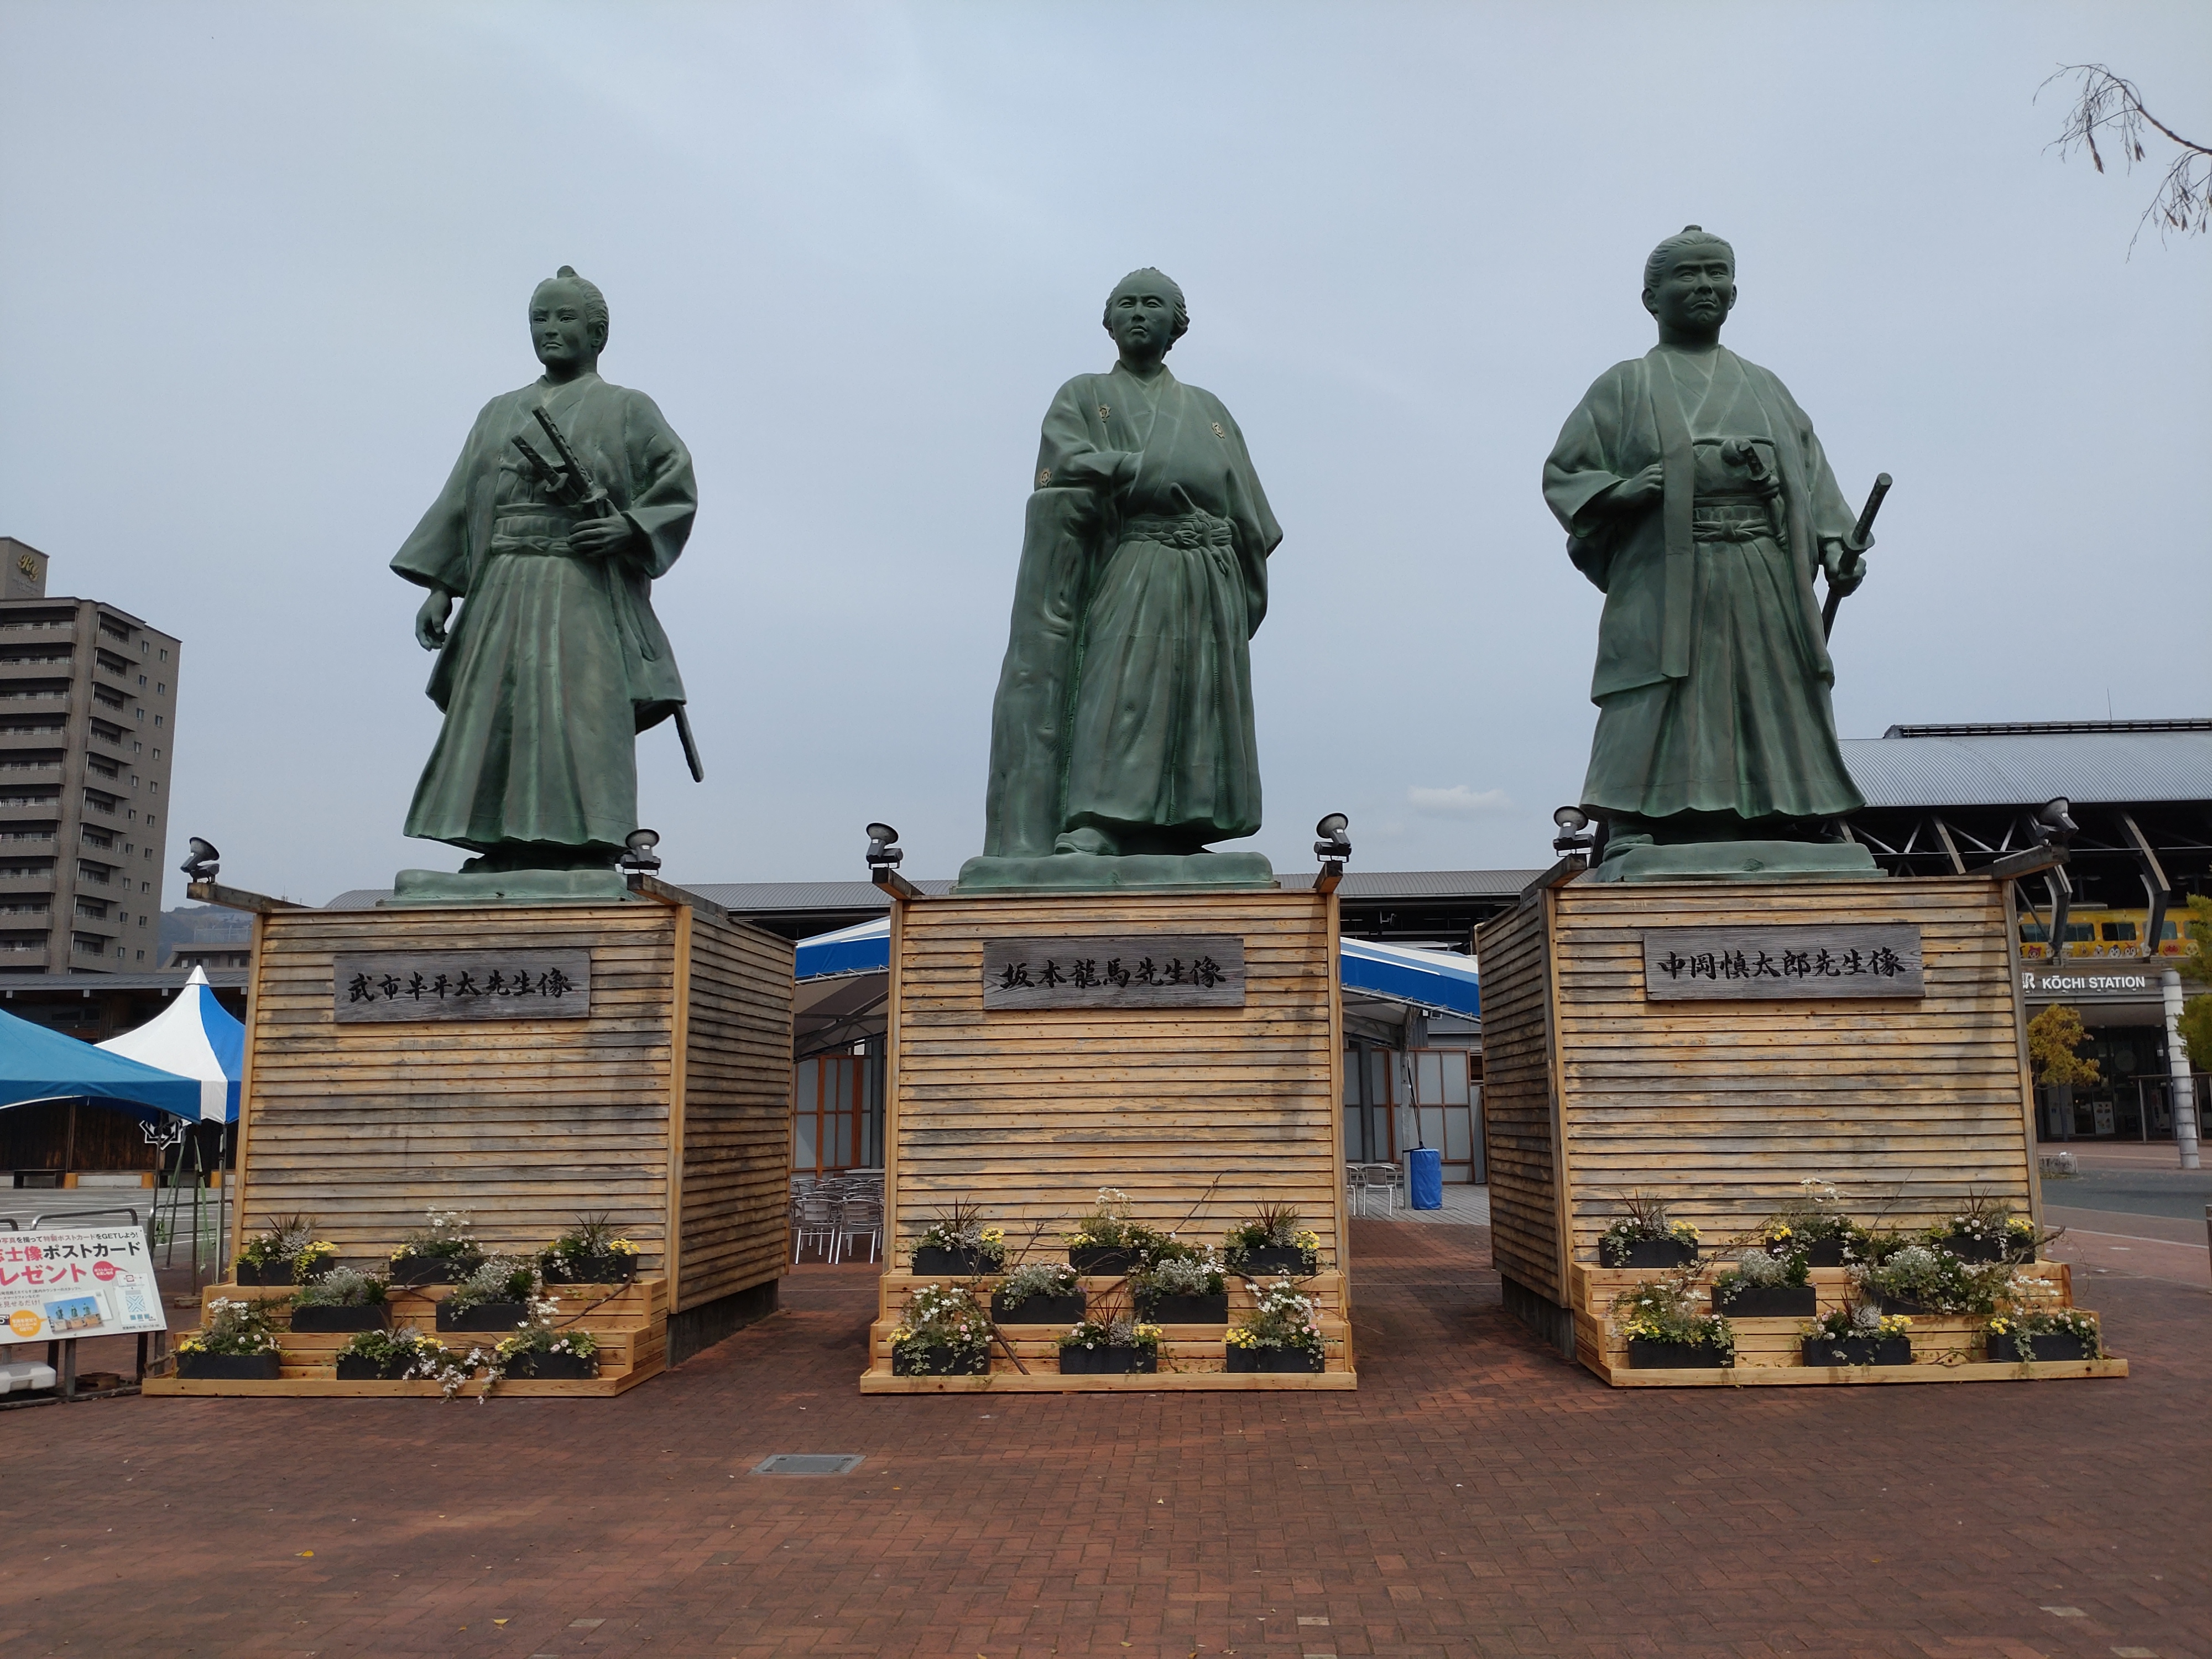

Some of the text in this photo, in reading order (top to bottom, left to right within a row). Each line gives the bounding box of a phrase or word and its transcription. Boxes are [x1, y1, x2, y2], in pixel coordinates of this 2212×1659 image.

[999, 956, 1225, 988] 坂本龍馬先生像
[1659, 947, 1905, 979] 中岡慎太郎先生像
[348, 967, 572, 1003] 武市半平太先生像
[2089, 976, 2145, 988] STATION
[0, 1232, 138, 1244] 写真を撮って特製ポストカードをGETしよう!
[0, 1241, 140, 1262] 士像ポストカード
